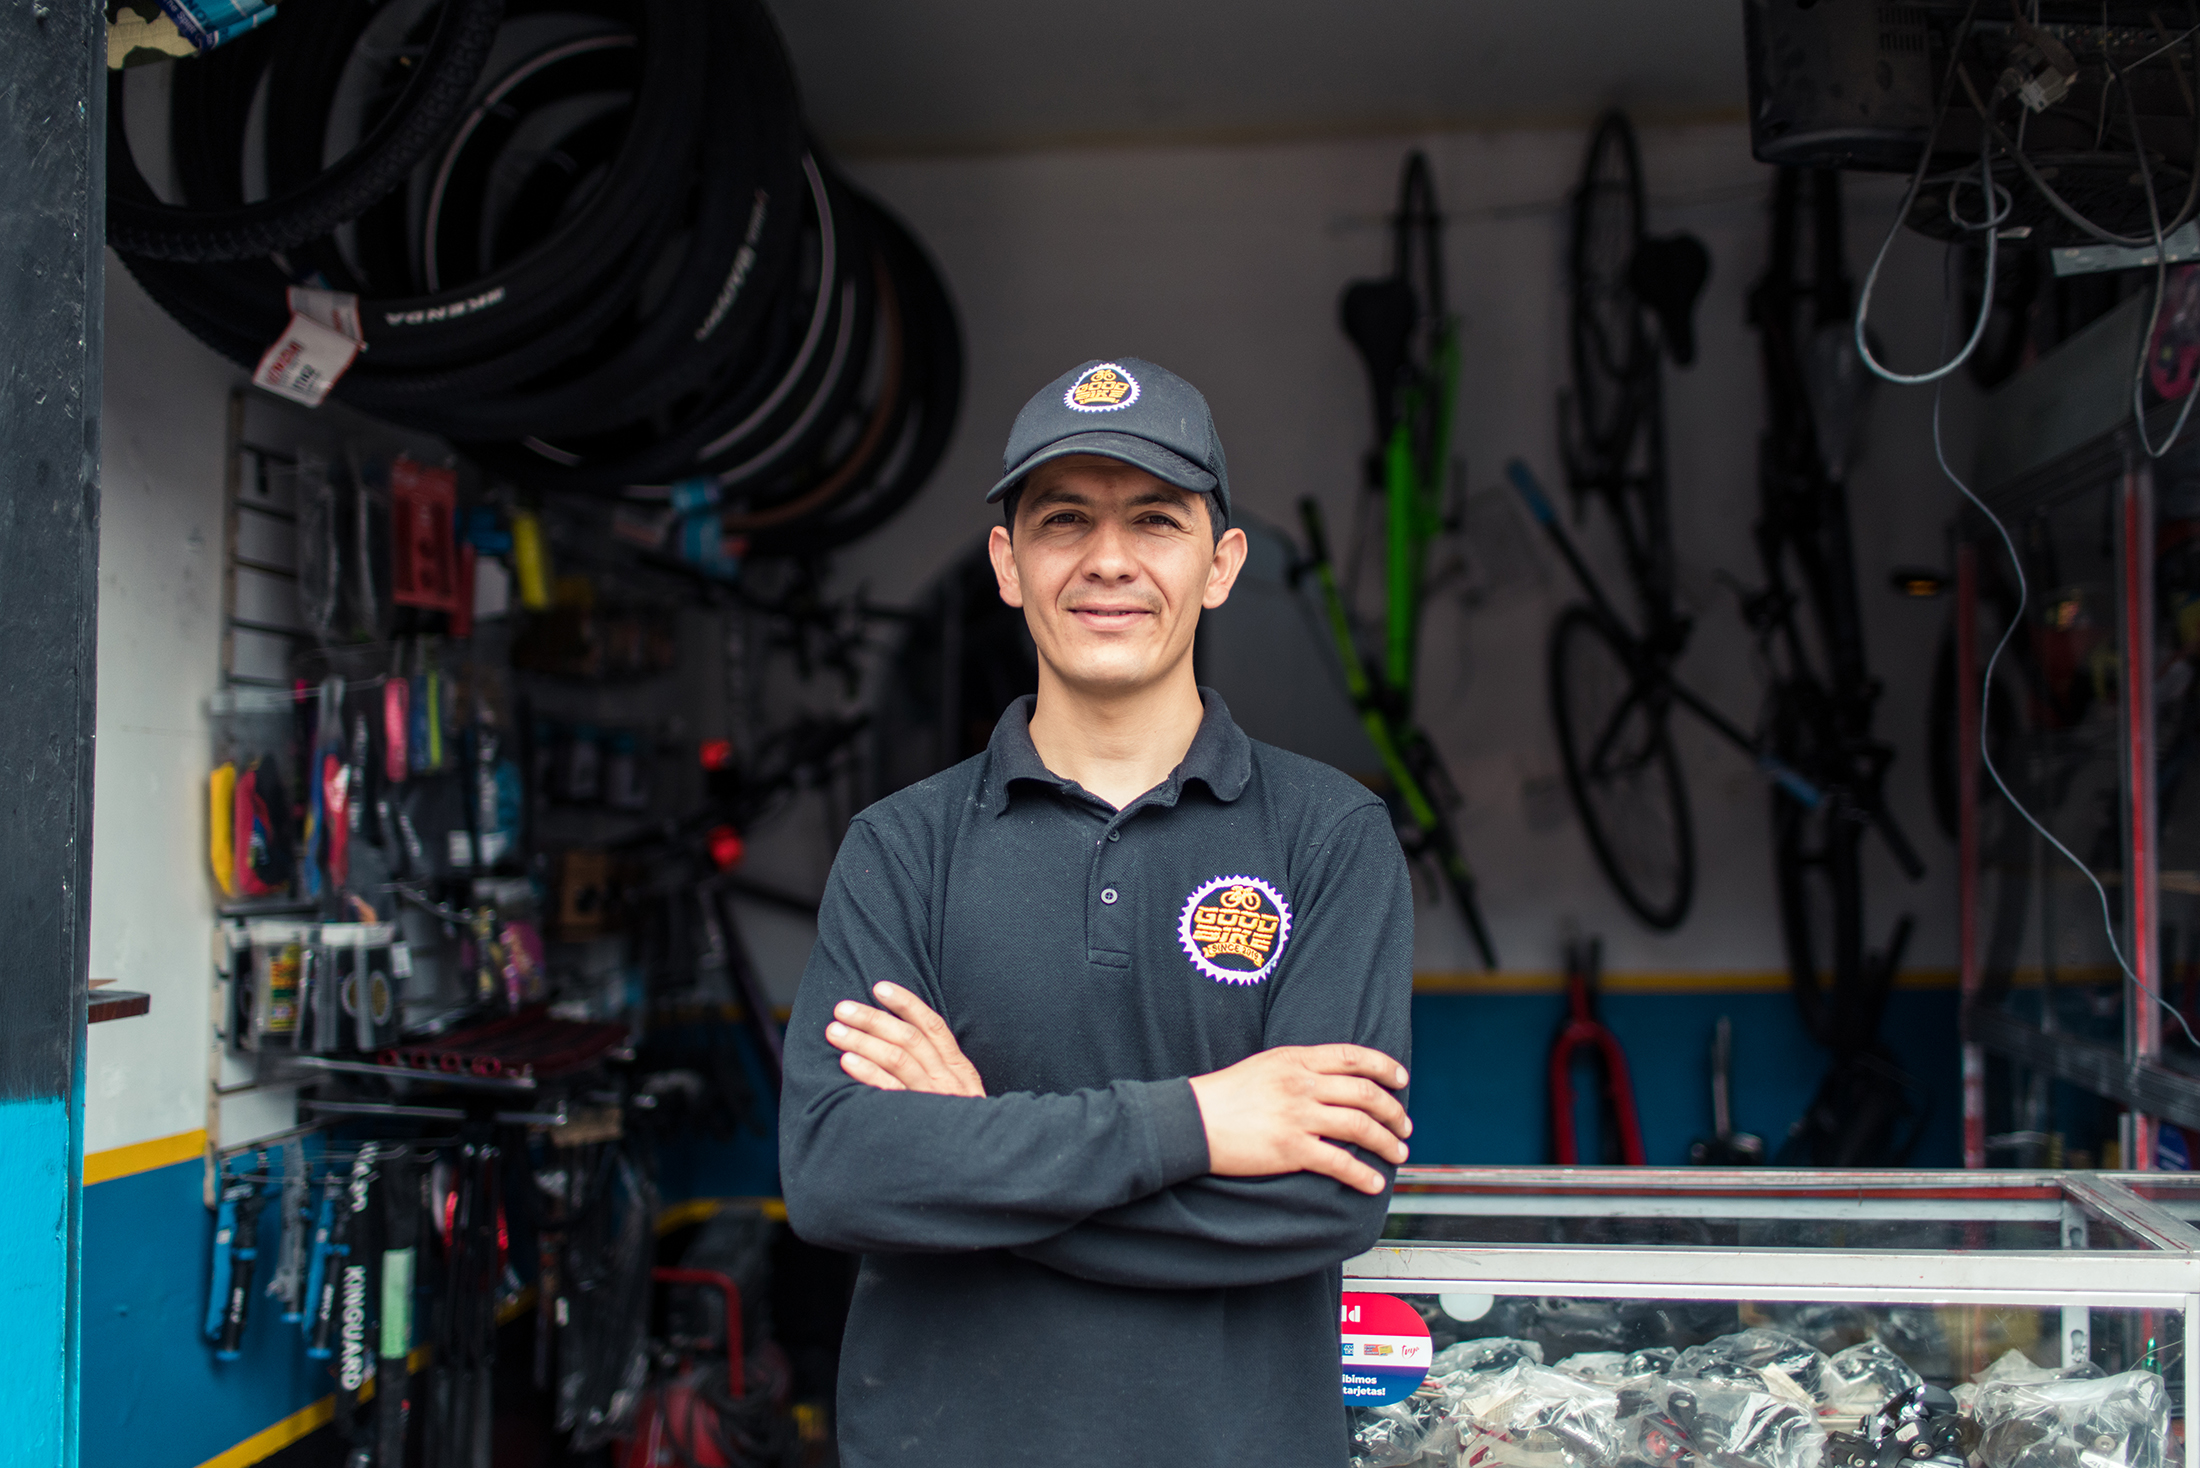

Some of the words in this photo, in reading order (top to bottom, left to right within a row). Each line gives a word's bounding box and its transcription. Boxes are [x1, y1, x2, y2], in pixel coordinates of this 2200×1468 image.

[1074, 381, 1130, 394] GOOD
[1193, 905, 1280, 934] GOOD
[1191, 922, 1274, 953] BIKE
[1211, 943, 1240, 953] SINCE
[1242, 946, 1259, 960] 2019
[341, 1265, 367, 1391] KINGUARD
[1342, 1386, 1386, 1397] tarjetas!
